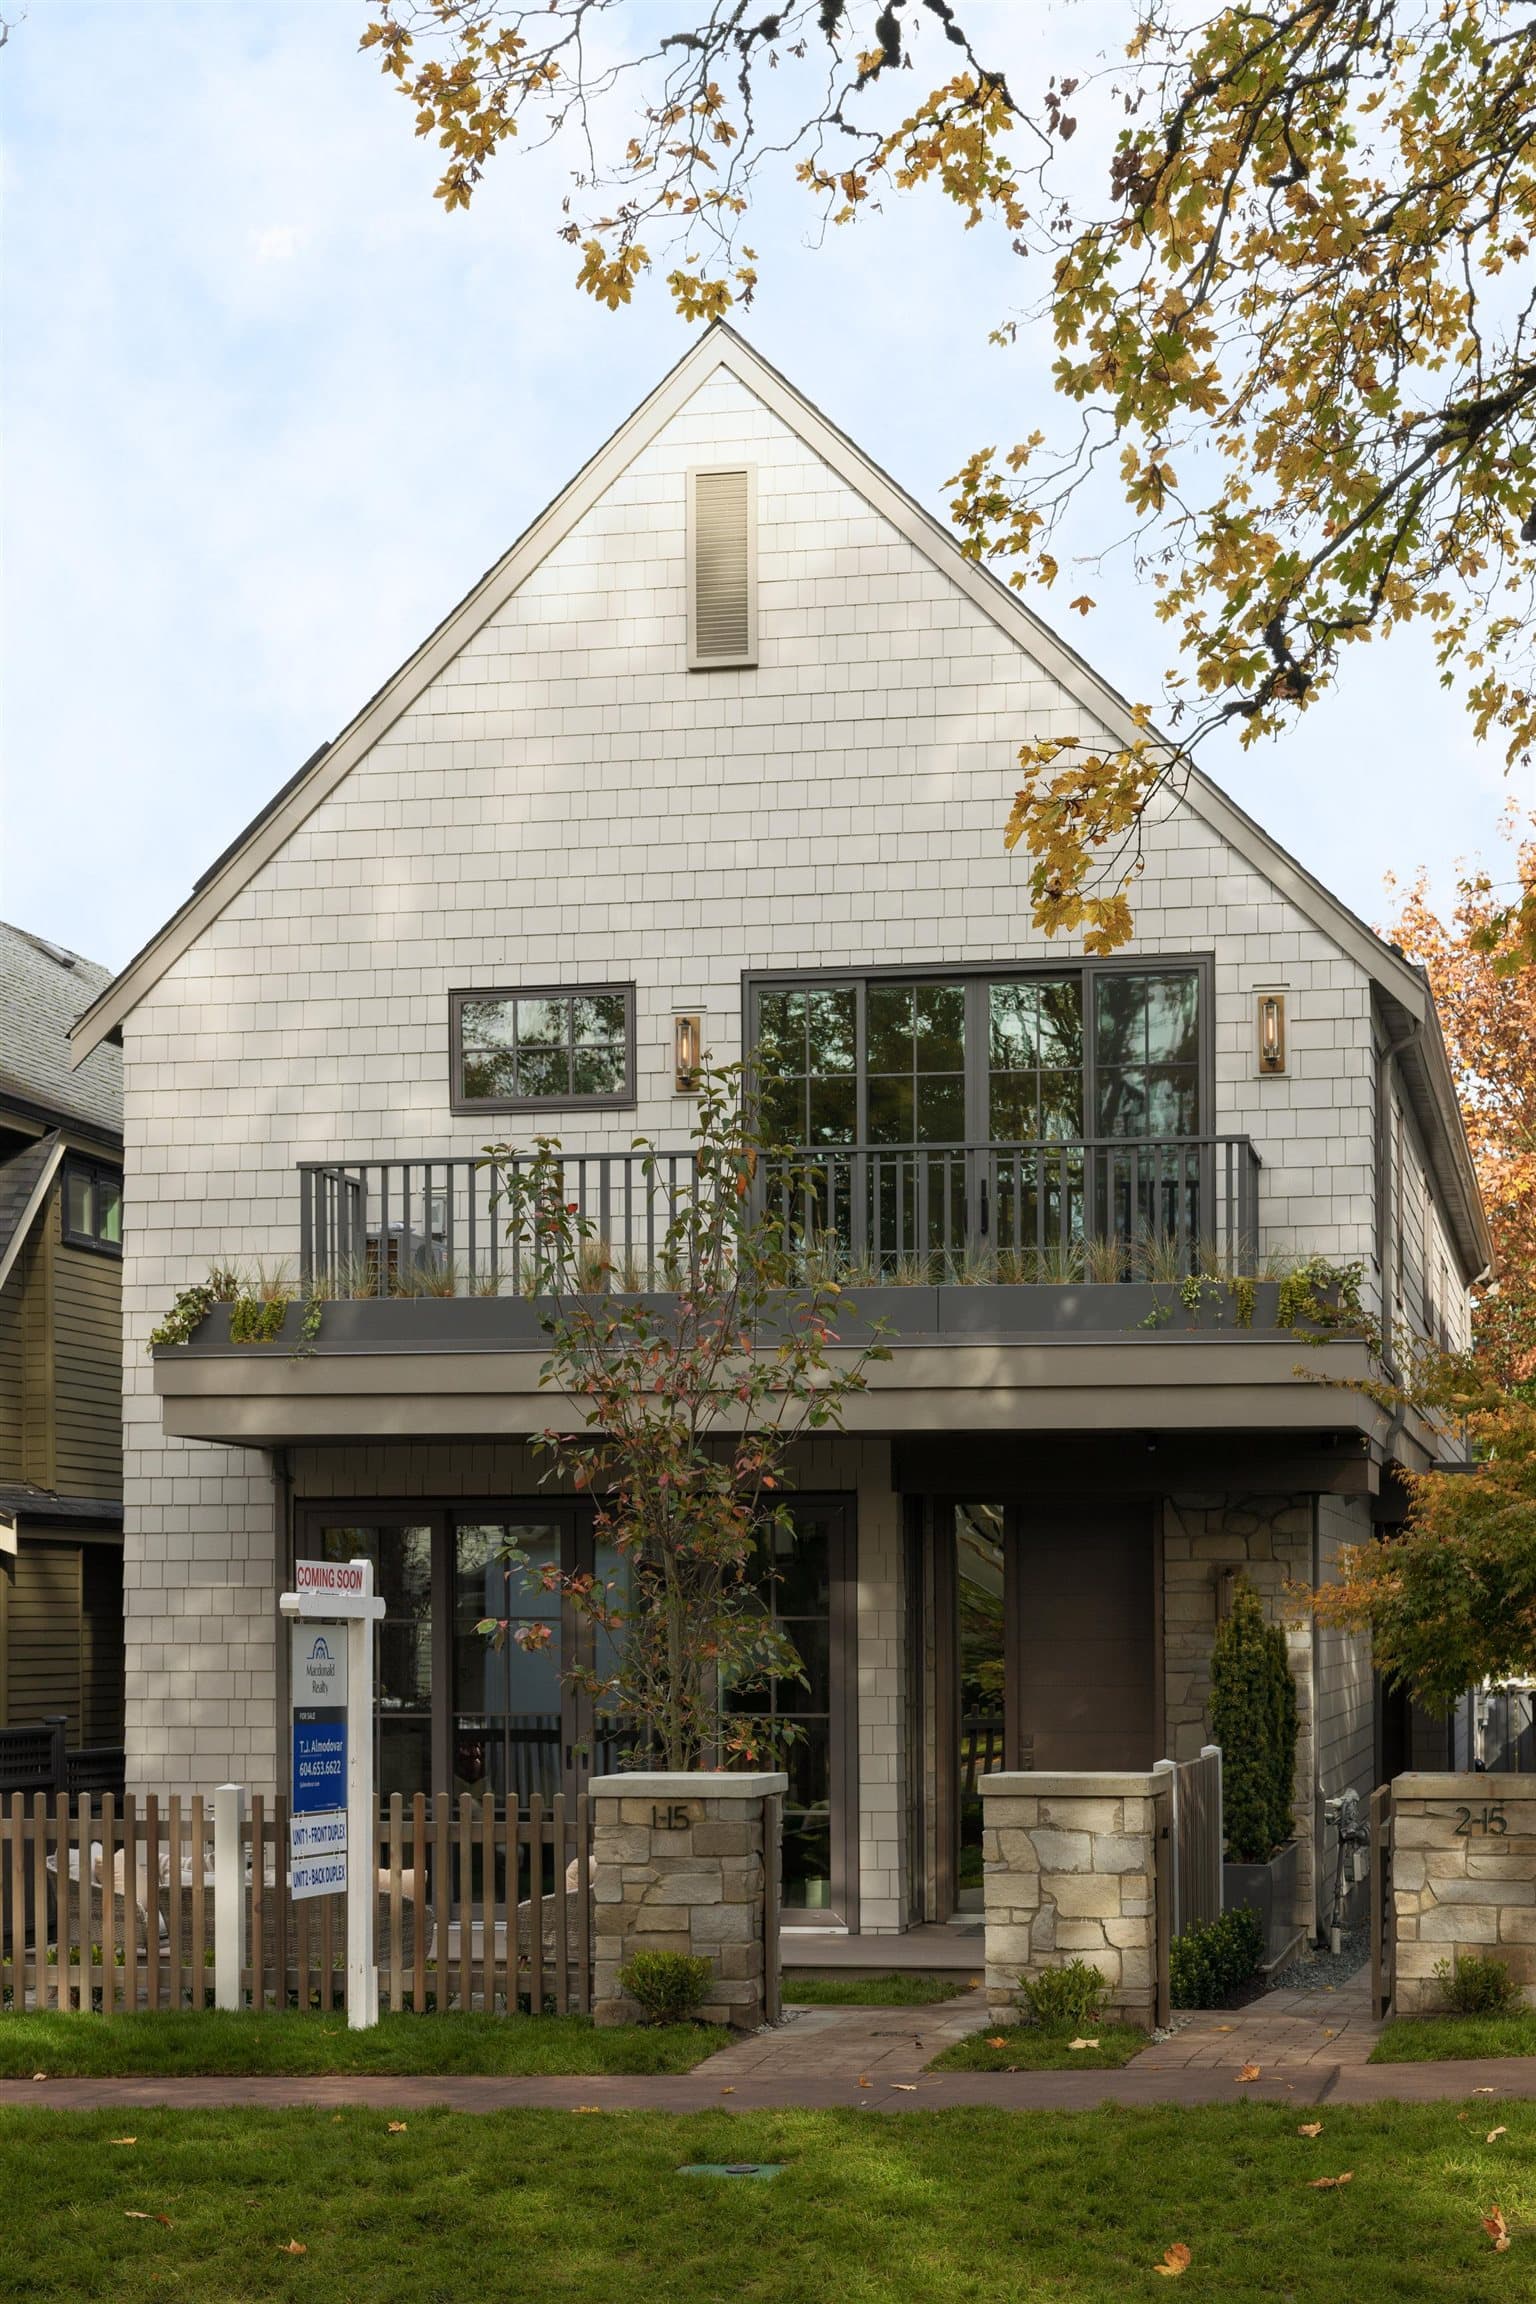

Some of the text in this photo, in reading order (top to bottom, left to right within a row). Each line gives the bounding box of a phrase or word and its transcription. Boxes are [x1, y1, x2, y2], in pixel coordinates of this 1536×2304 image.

[297, 1567, 363, 1589] COMING SOON
[306, 1664, 335, 1677] Macdonald
[312, 1680, 328, 1696] Realty
[299, 1712, 316, 1720] FOR SALE
[311, 1738, 343, 1752] Almodovar
[293, 1828, 305, 1845] UNIT
[311, 1826, 327, 1843] FRONT
[328, 1824, 345, 1841] DUPLEX
[293, 1870, 305, 1888] UNIT
[312, 1867, 325, 1885] BACK
[326, 1864, 345, 1882] DUPLEX
